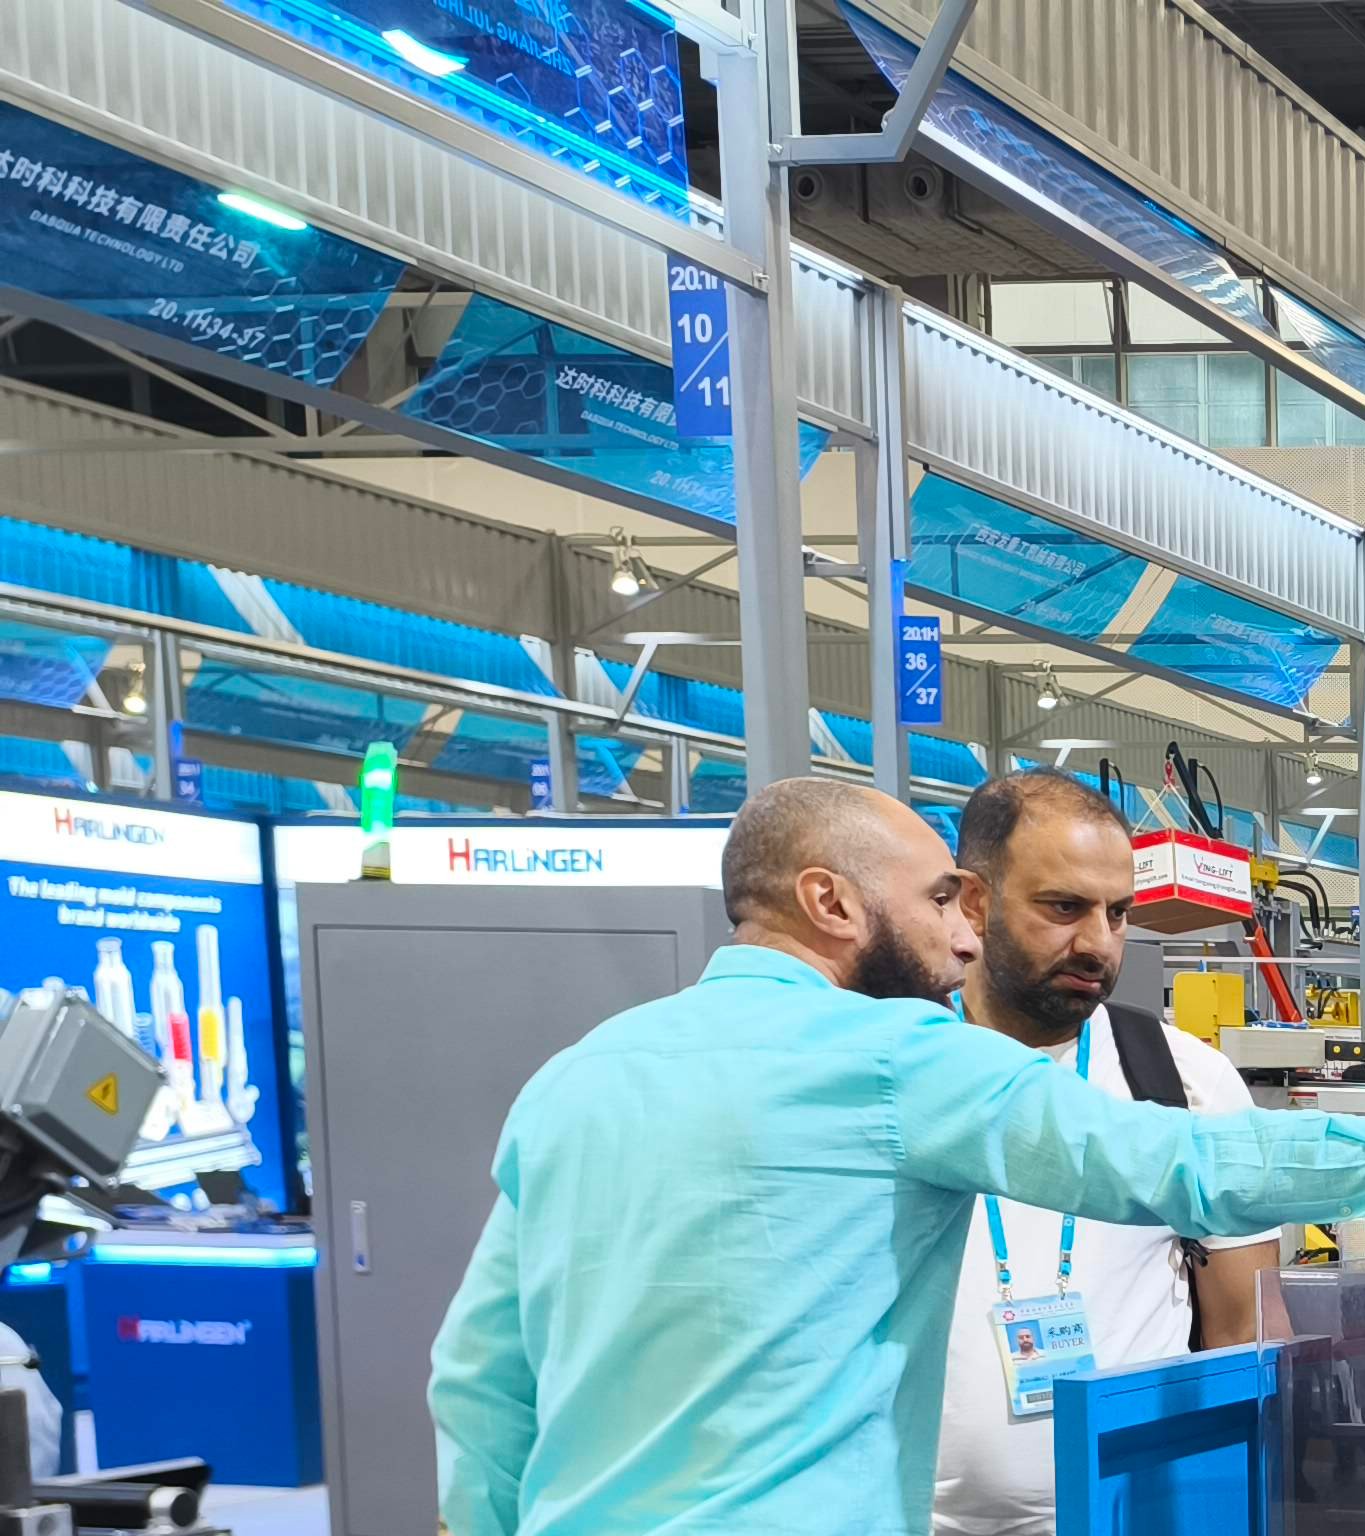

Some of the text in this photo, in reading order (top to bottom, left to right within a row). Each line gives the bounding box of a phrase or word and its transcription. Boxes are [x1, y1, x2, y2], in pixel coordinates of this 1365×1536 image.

[83, 228, 163, 266] TECHNOLOGY
[677, 313, 713, 344] 10
[697, 376, 731, 407] 11
[902, 625, 939, 641] 20.1H
[904, 652, 928, 671] 36
[915, 687, 939, 705] 37
[1052, 1337, 1086, 1350] BUYER
